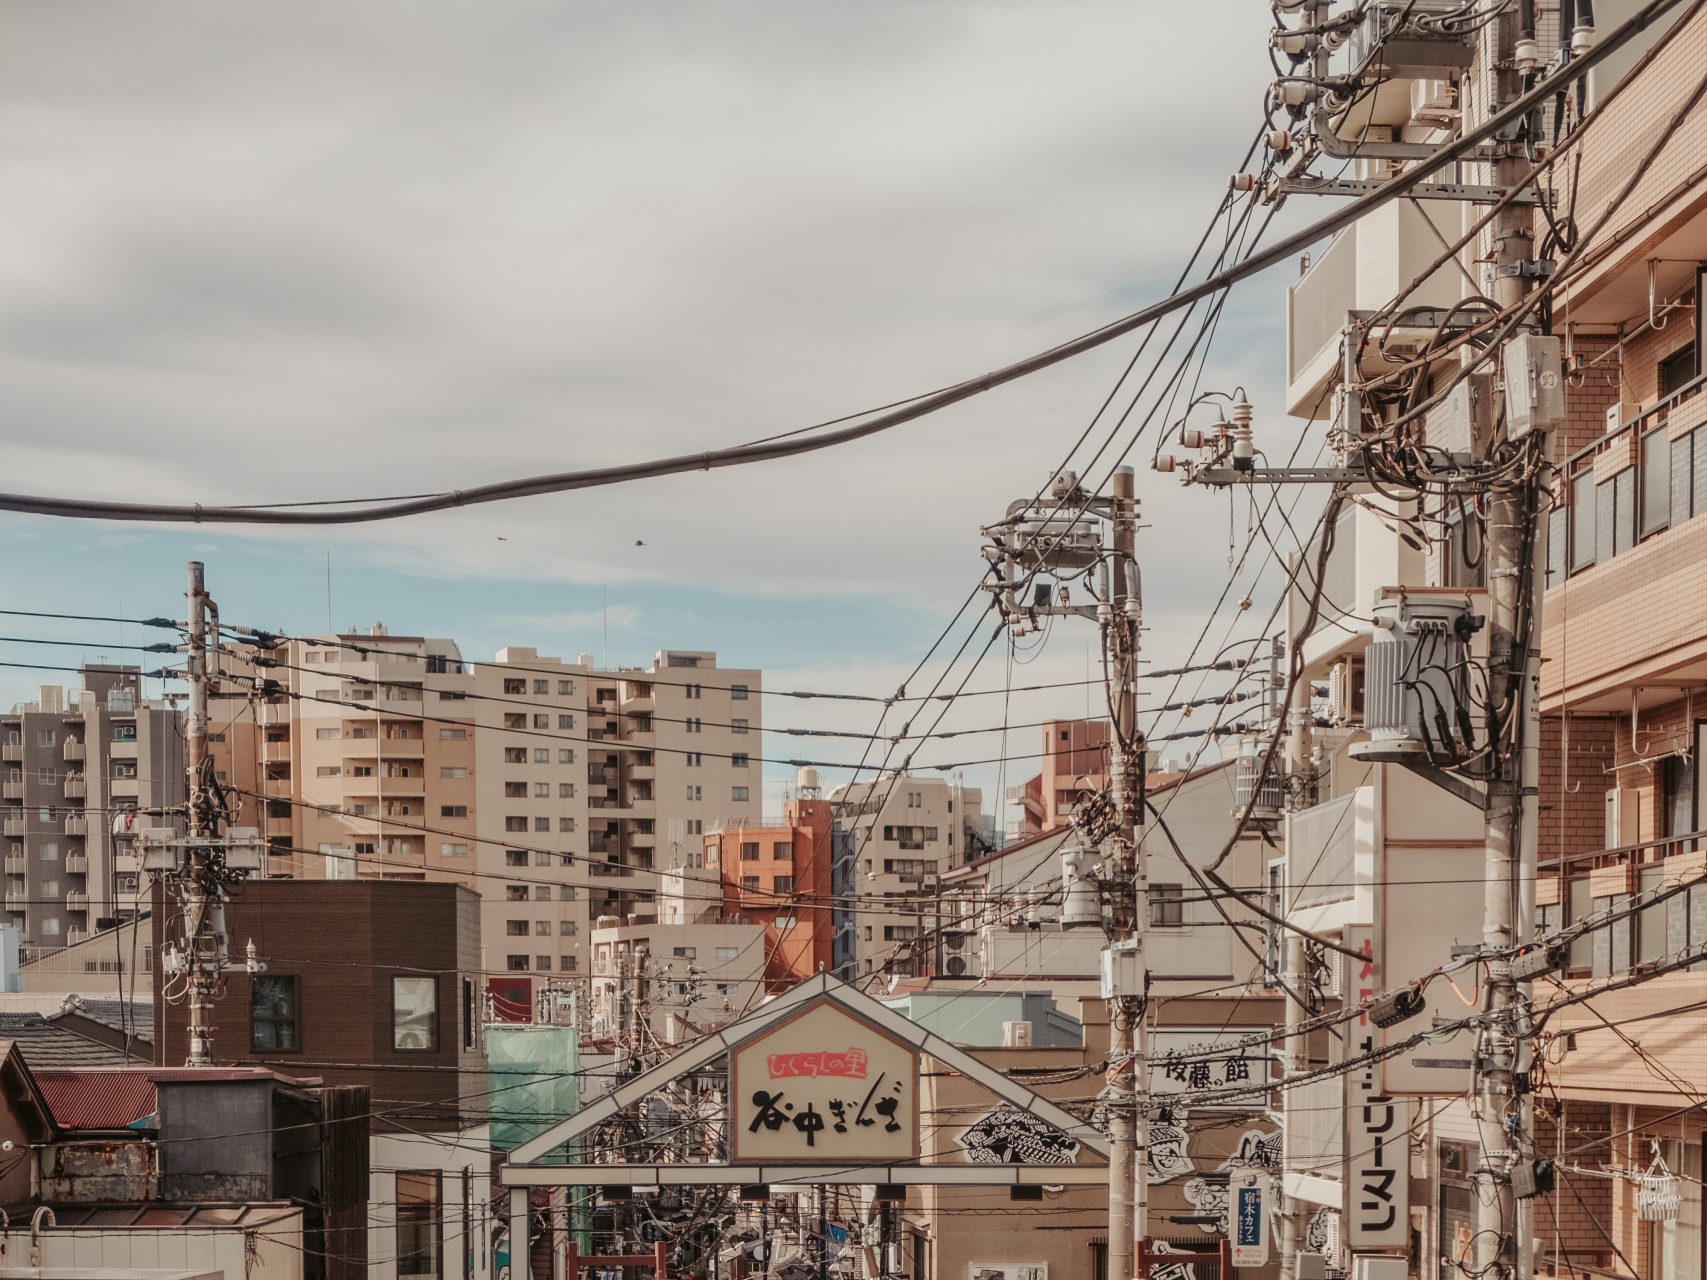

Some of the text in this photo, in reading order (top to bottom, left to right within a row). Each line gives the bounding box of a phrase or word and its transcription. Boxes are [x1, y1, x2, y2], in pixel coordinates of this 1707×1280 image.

[770, 1047, 867, 1078] ひぐらしの里
[748, 1071, 903, 1147] 谷中ぎんざ
[1244, 1191, 1256, 1242] 宿木カフェ
